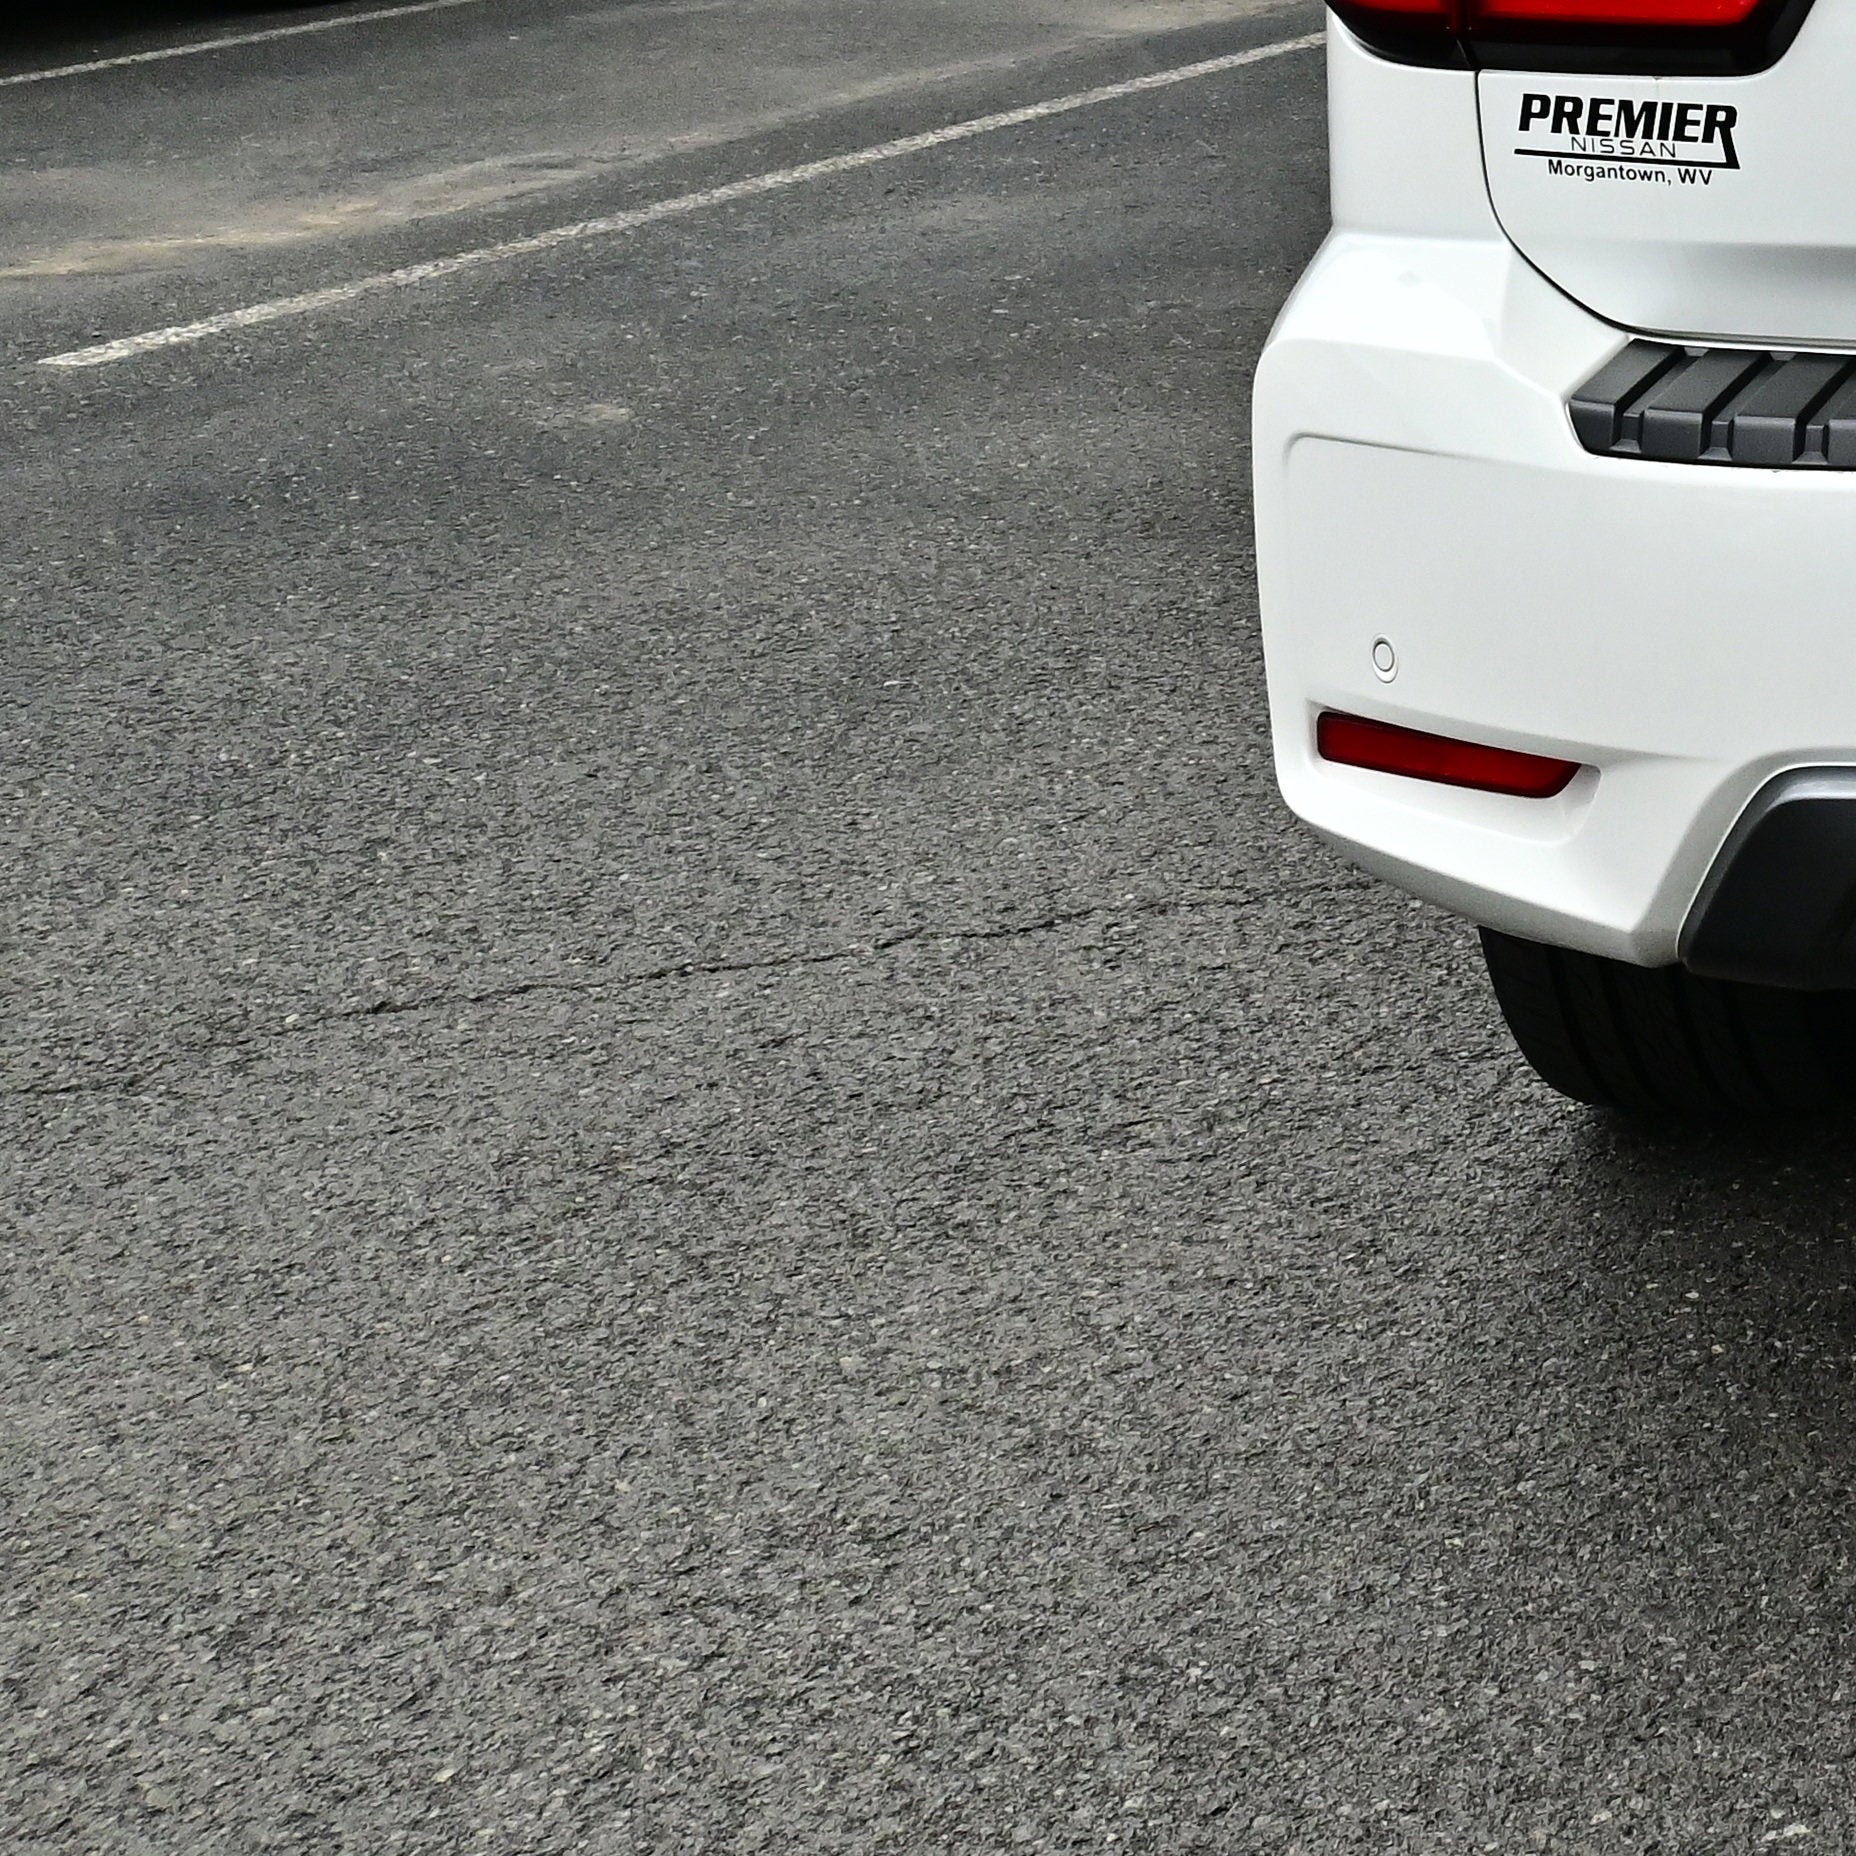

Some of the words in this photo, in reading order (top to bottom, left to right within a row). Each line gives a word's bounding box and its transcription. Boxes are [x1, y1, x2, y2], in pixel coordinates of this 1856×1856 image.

[1518, 93, 1739, 147] PREMIER
[1570, 136, 1677, 158] NISSAN
[1548, 159, 1673, 186] Morgantown,
[1677, 168, 1713, 186] WV
